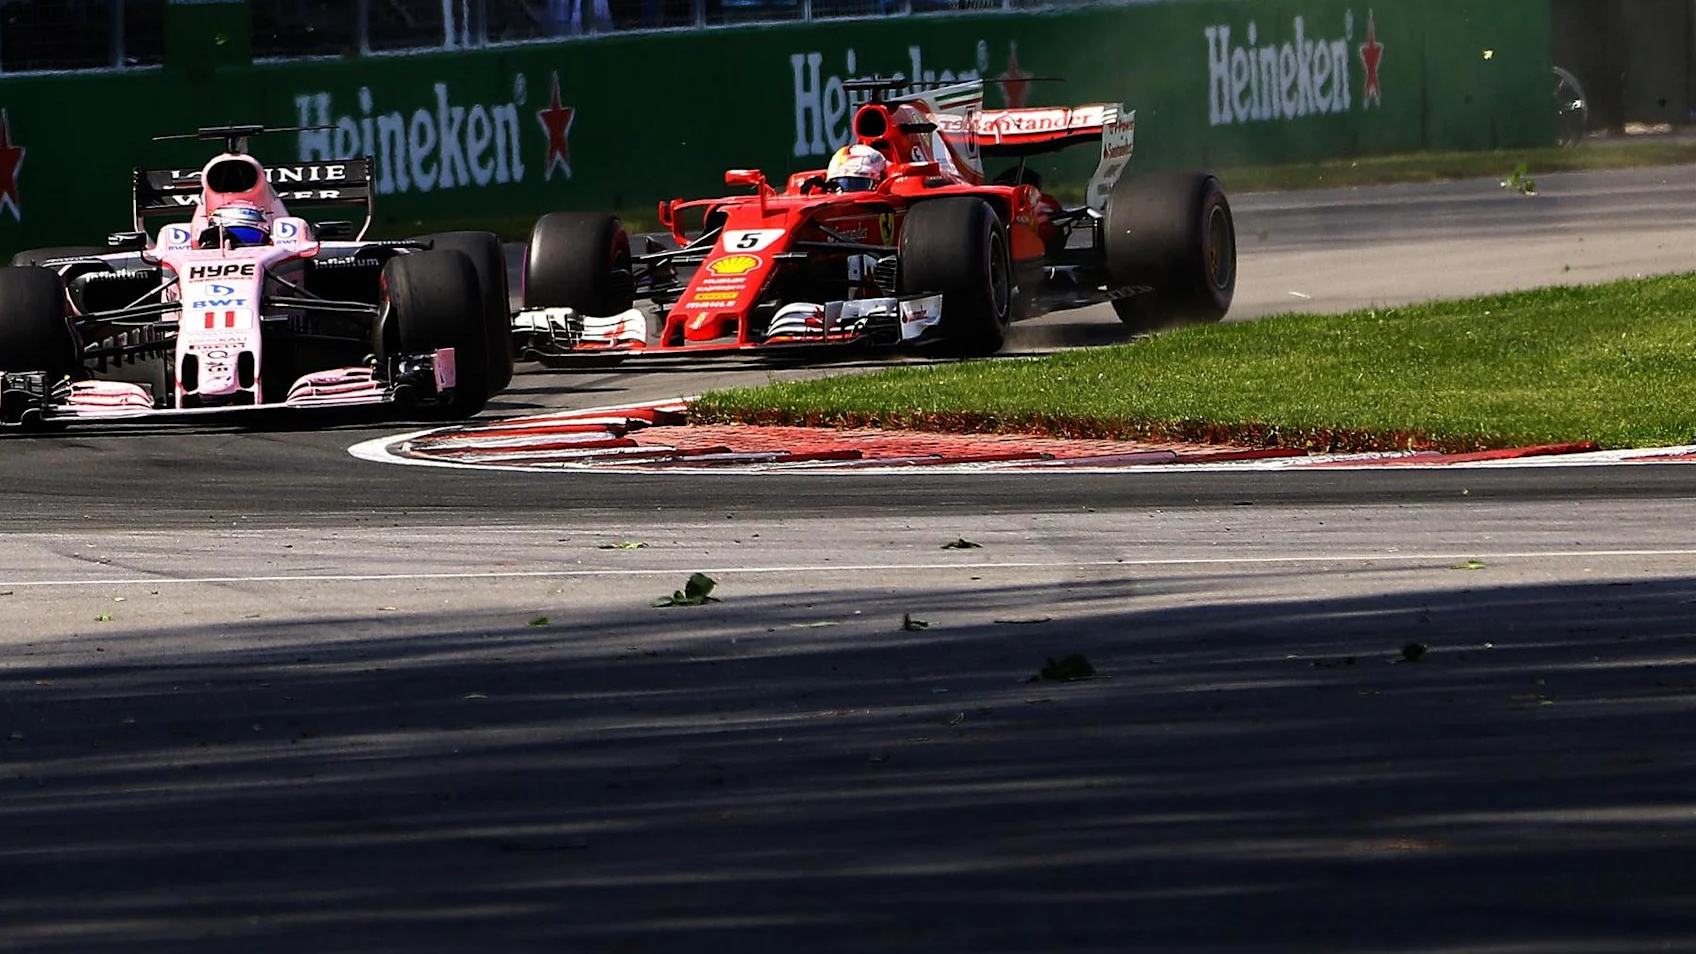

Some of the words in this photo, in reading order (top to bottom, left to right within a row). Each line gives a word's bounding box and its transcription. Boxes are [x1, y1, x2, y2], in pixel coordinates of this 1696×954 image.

[1204, 15, 1352, 127] Heineken
[295, 82, 525, 195] Heineken
[737, 232, 762, 249] 5
[189, 263, 256, 279] HYPE
[193, 298, 247, 309] BWT
[203, 310, 236, 329] 11
